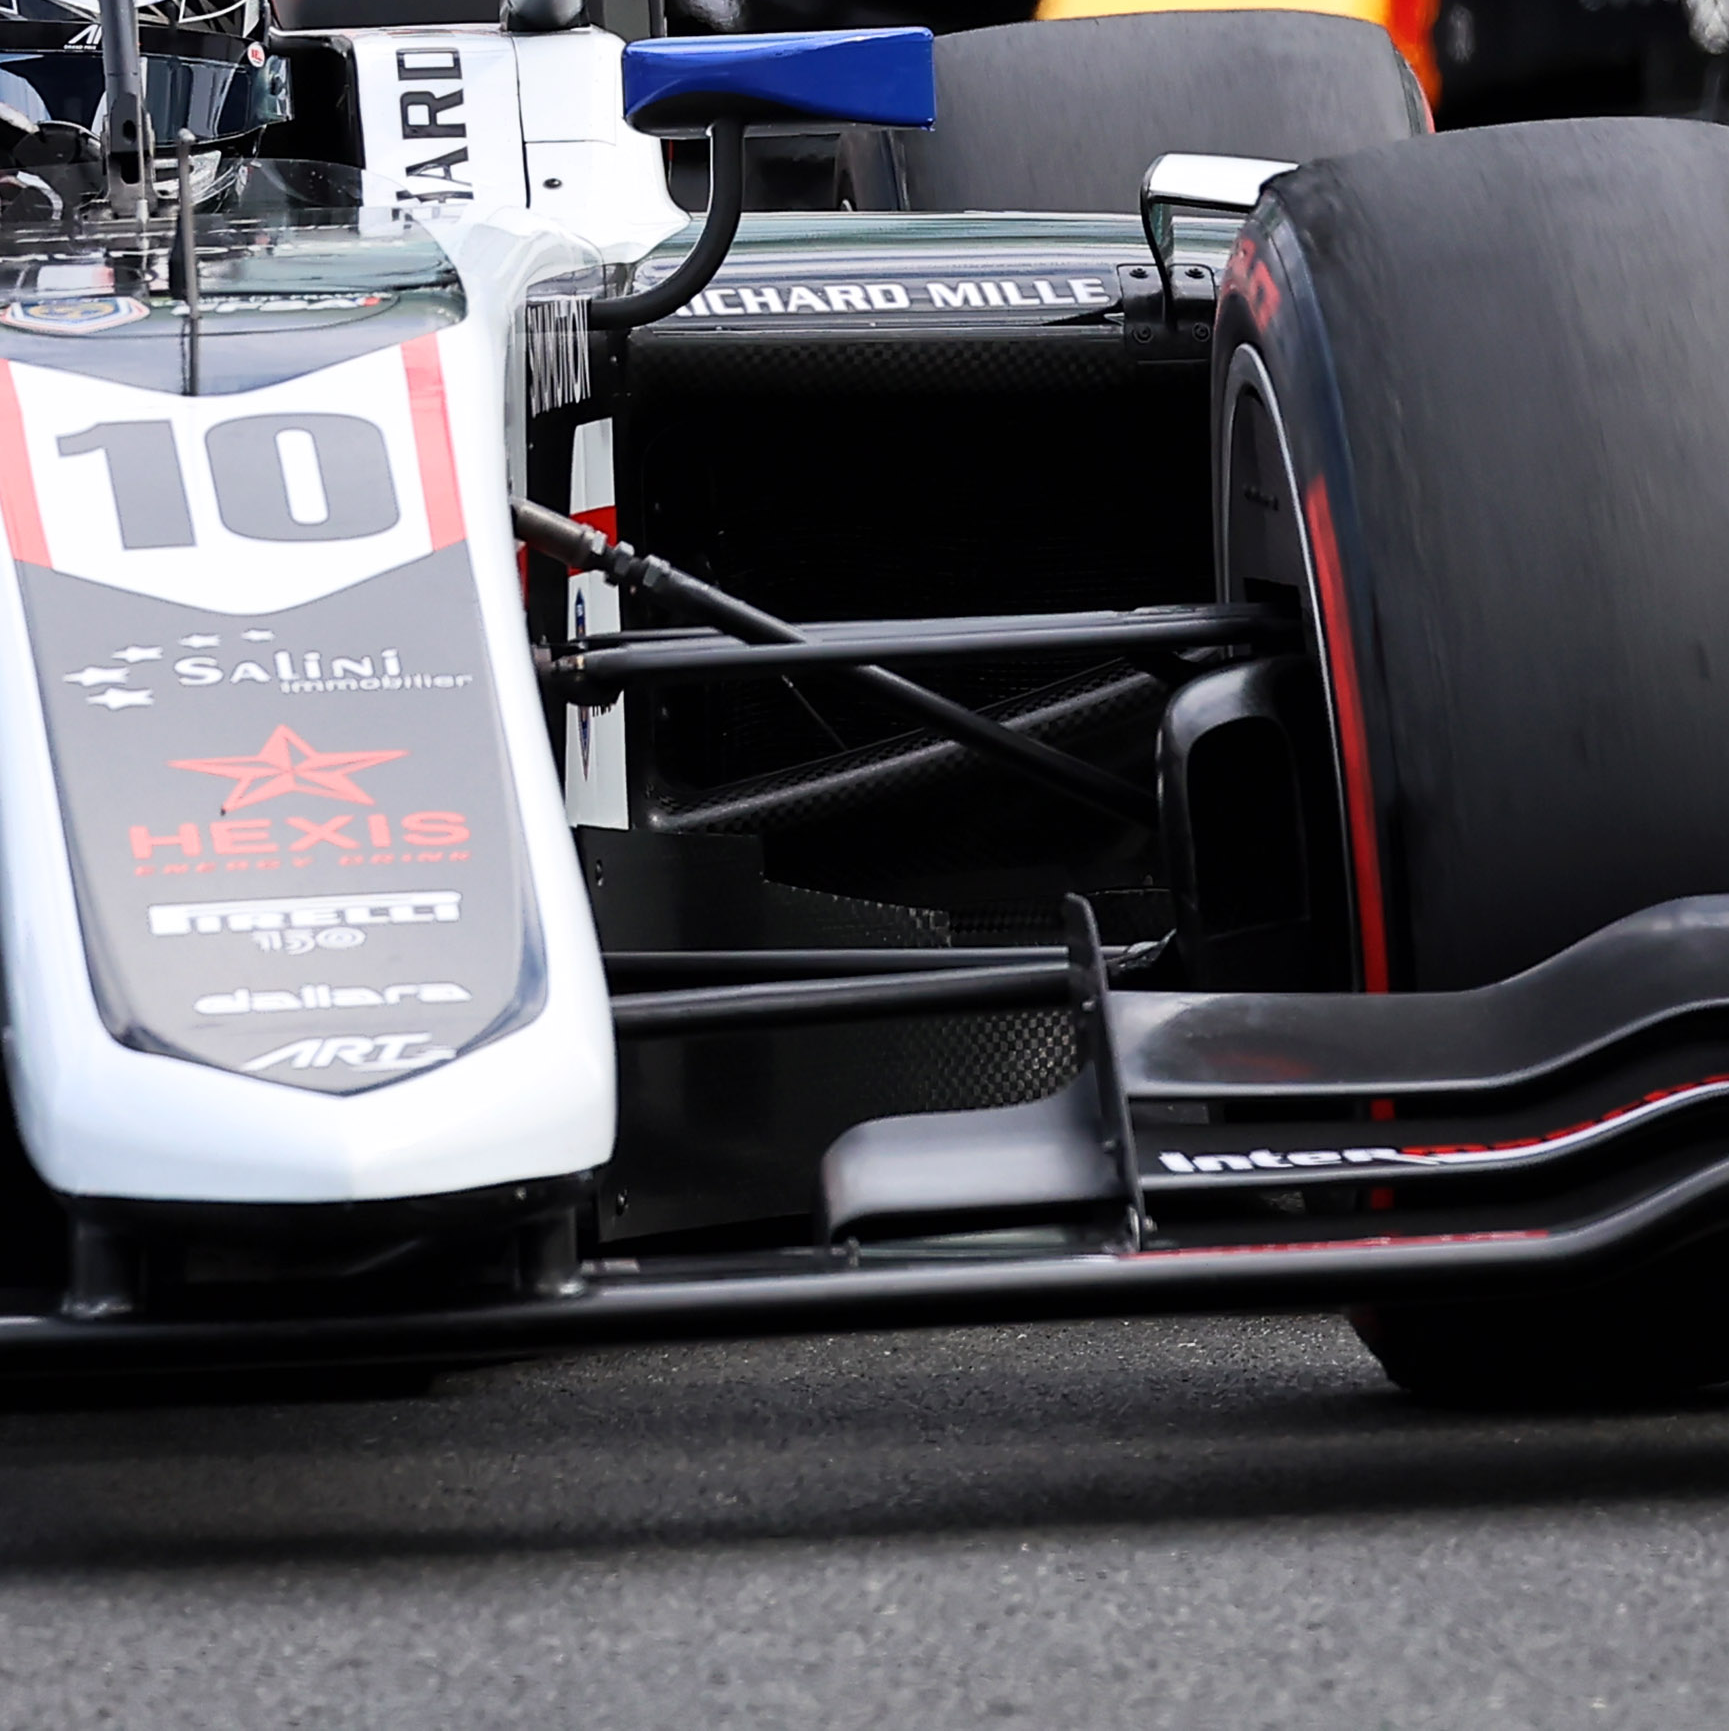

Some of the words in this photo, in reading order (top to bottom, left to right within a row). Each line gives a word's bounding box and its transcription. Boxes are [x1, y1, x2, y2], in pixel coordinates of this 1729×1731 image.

[924, 277, 1111, 308] MILLE
[56, 412, 401, 551] 10
[128, 811, 471, 860] HEXIS
[148, 889, 463, 937] PIRELLI
[193, 981, 472, 1016] dallara
